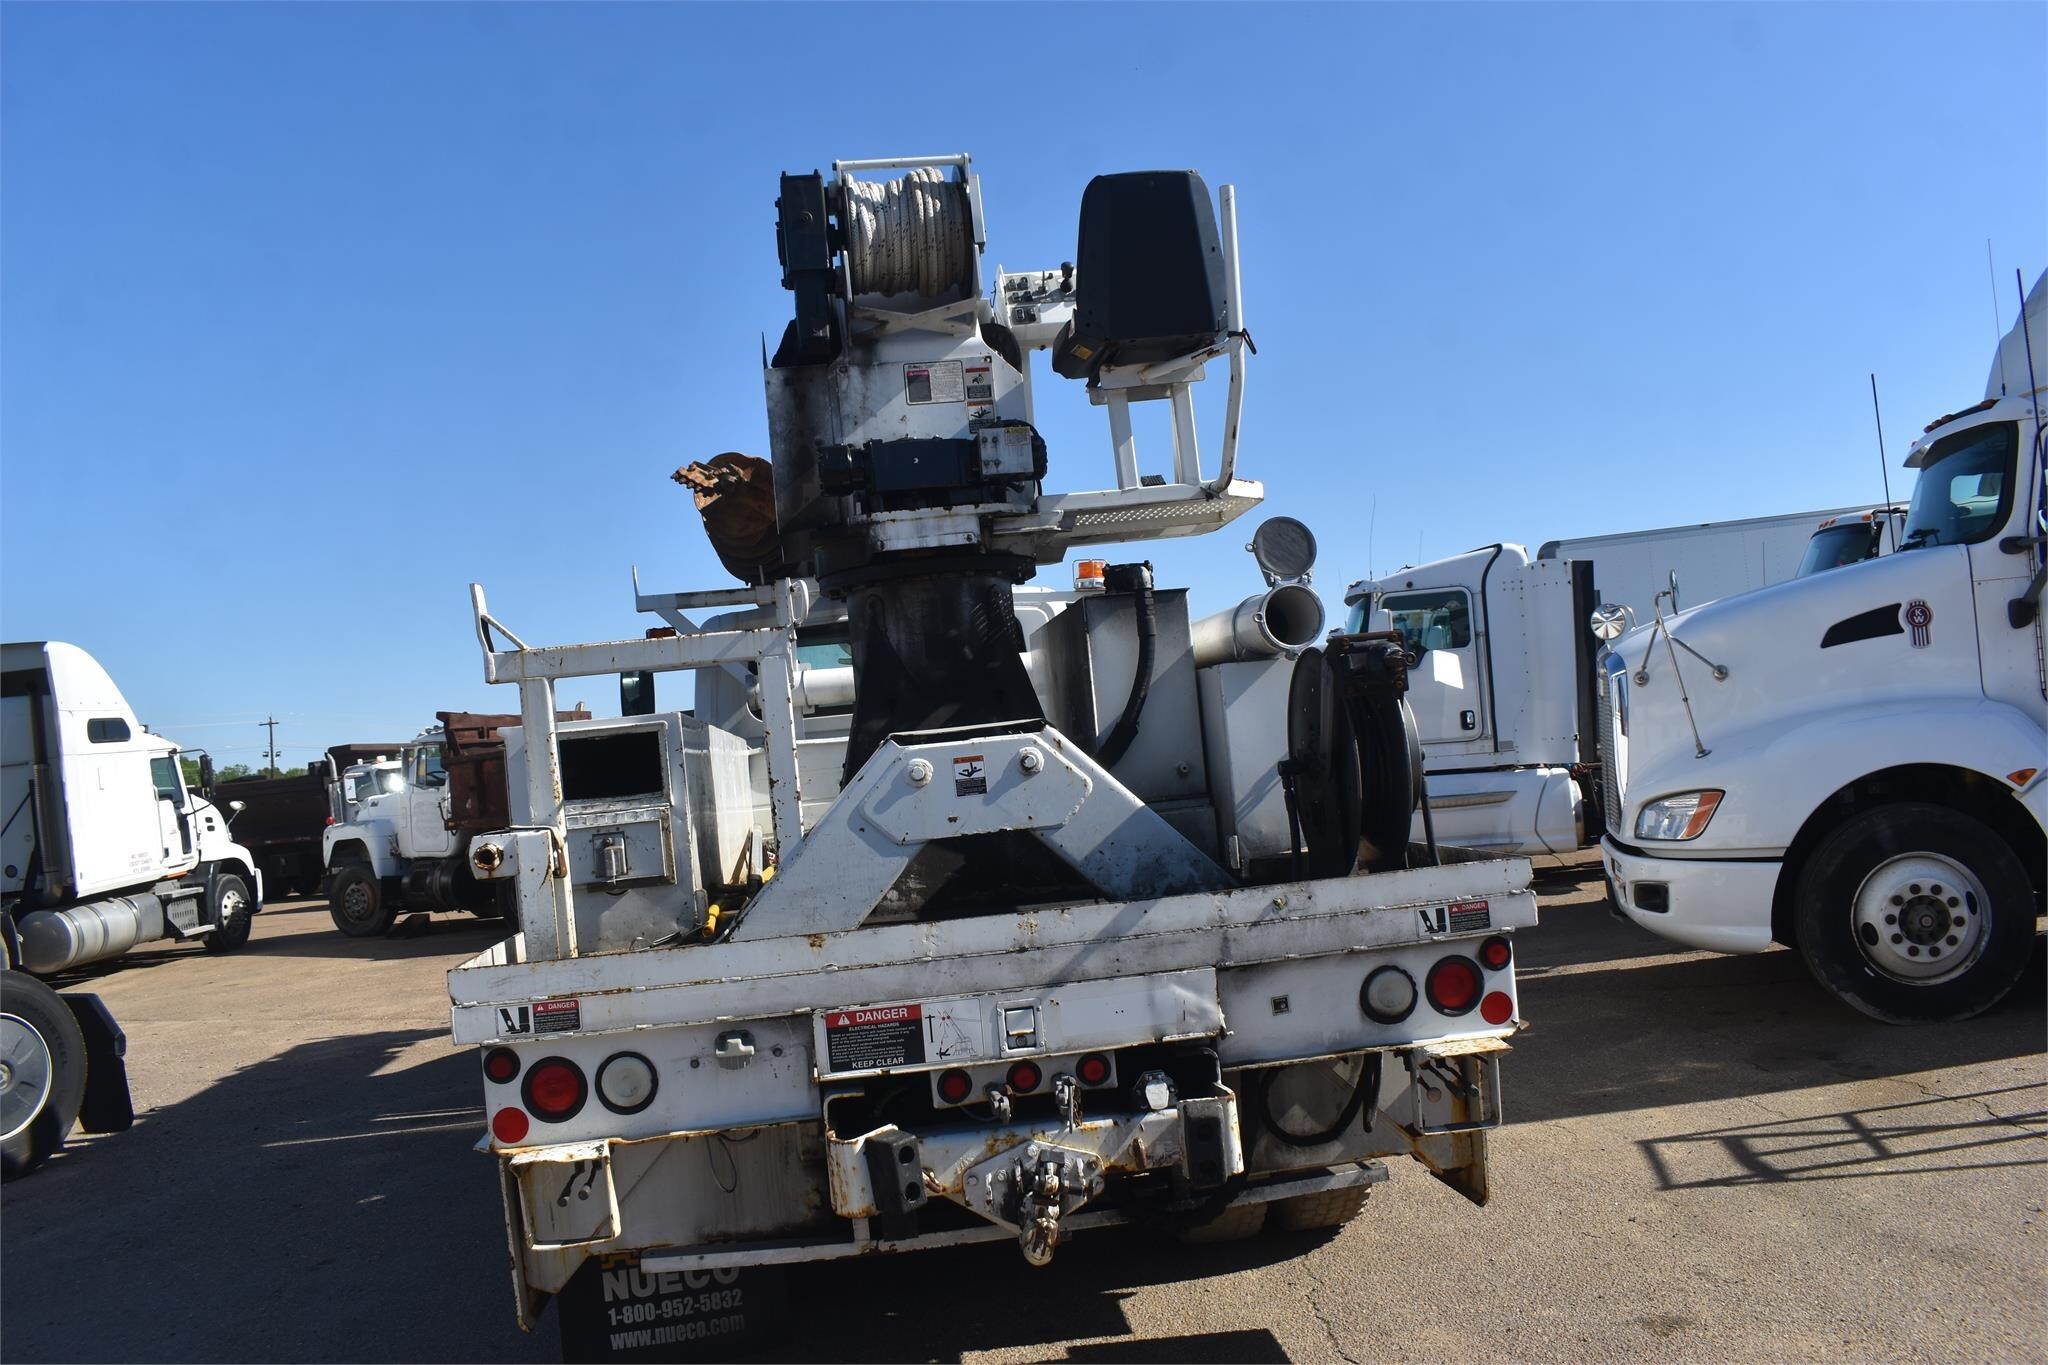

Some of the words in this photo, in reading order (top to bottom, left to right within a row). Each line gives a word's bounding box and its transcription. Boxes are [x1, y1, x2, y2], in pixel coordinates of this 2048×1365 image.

[1461, 902, 1486, 911] DANGER
[548, 1001, 576, 1010] DANGER
[856, 1007, 908, 1022] DANGER
[852, 1060, 874, 1069] KEEP
[876, 1057, 904, 1067] CLEAR
[602, 1266, 740, 1302] NUECO
[608, 1288, 743, 1326] 1-800-952-5832
[609, 1314, 745, 1351] www.nueco.com
